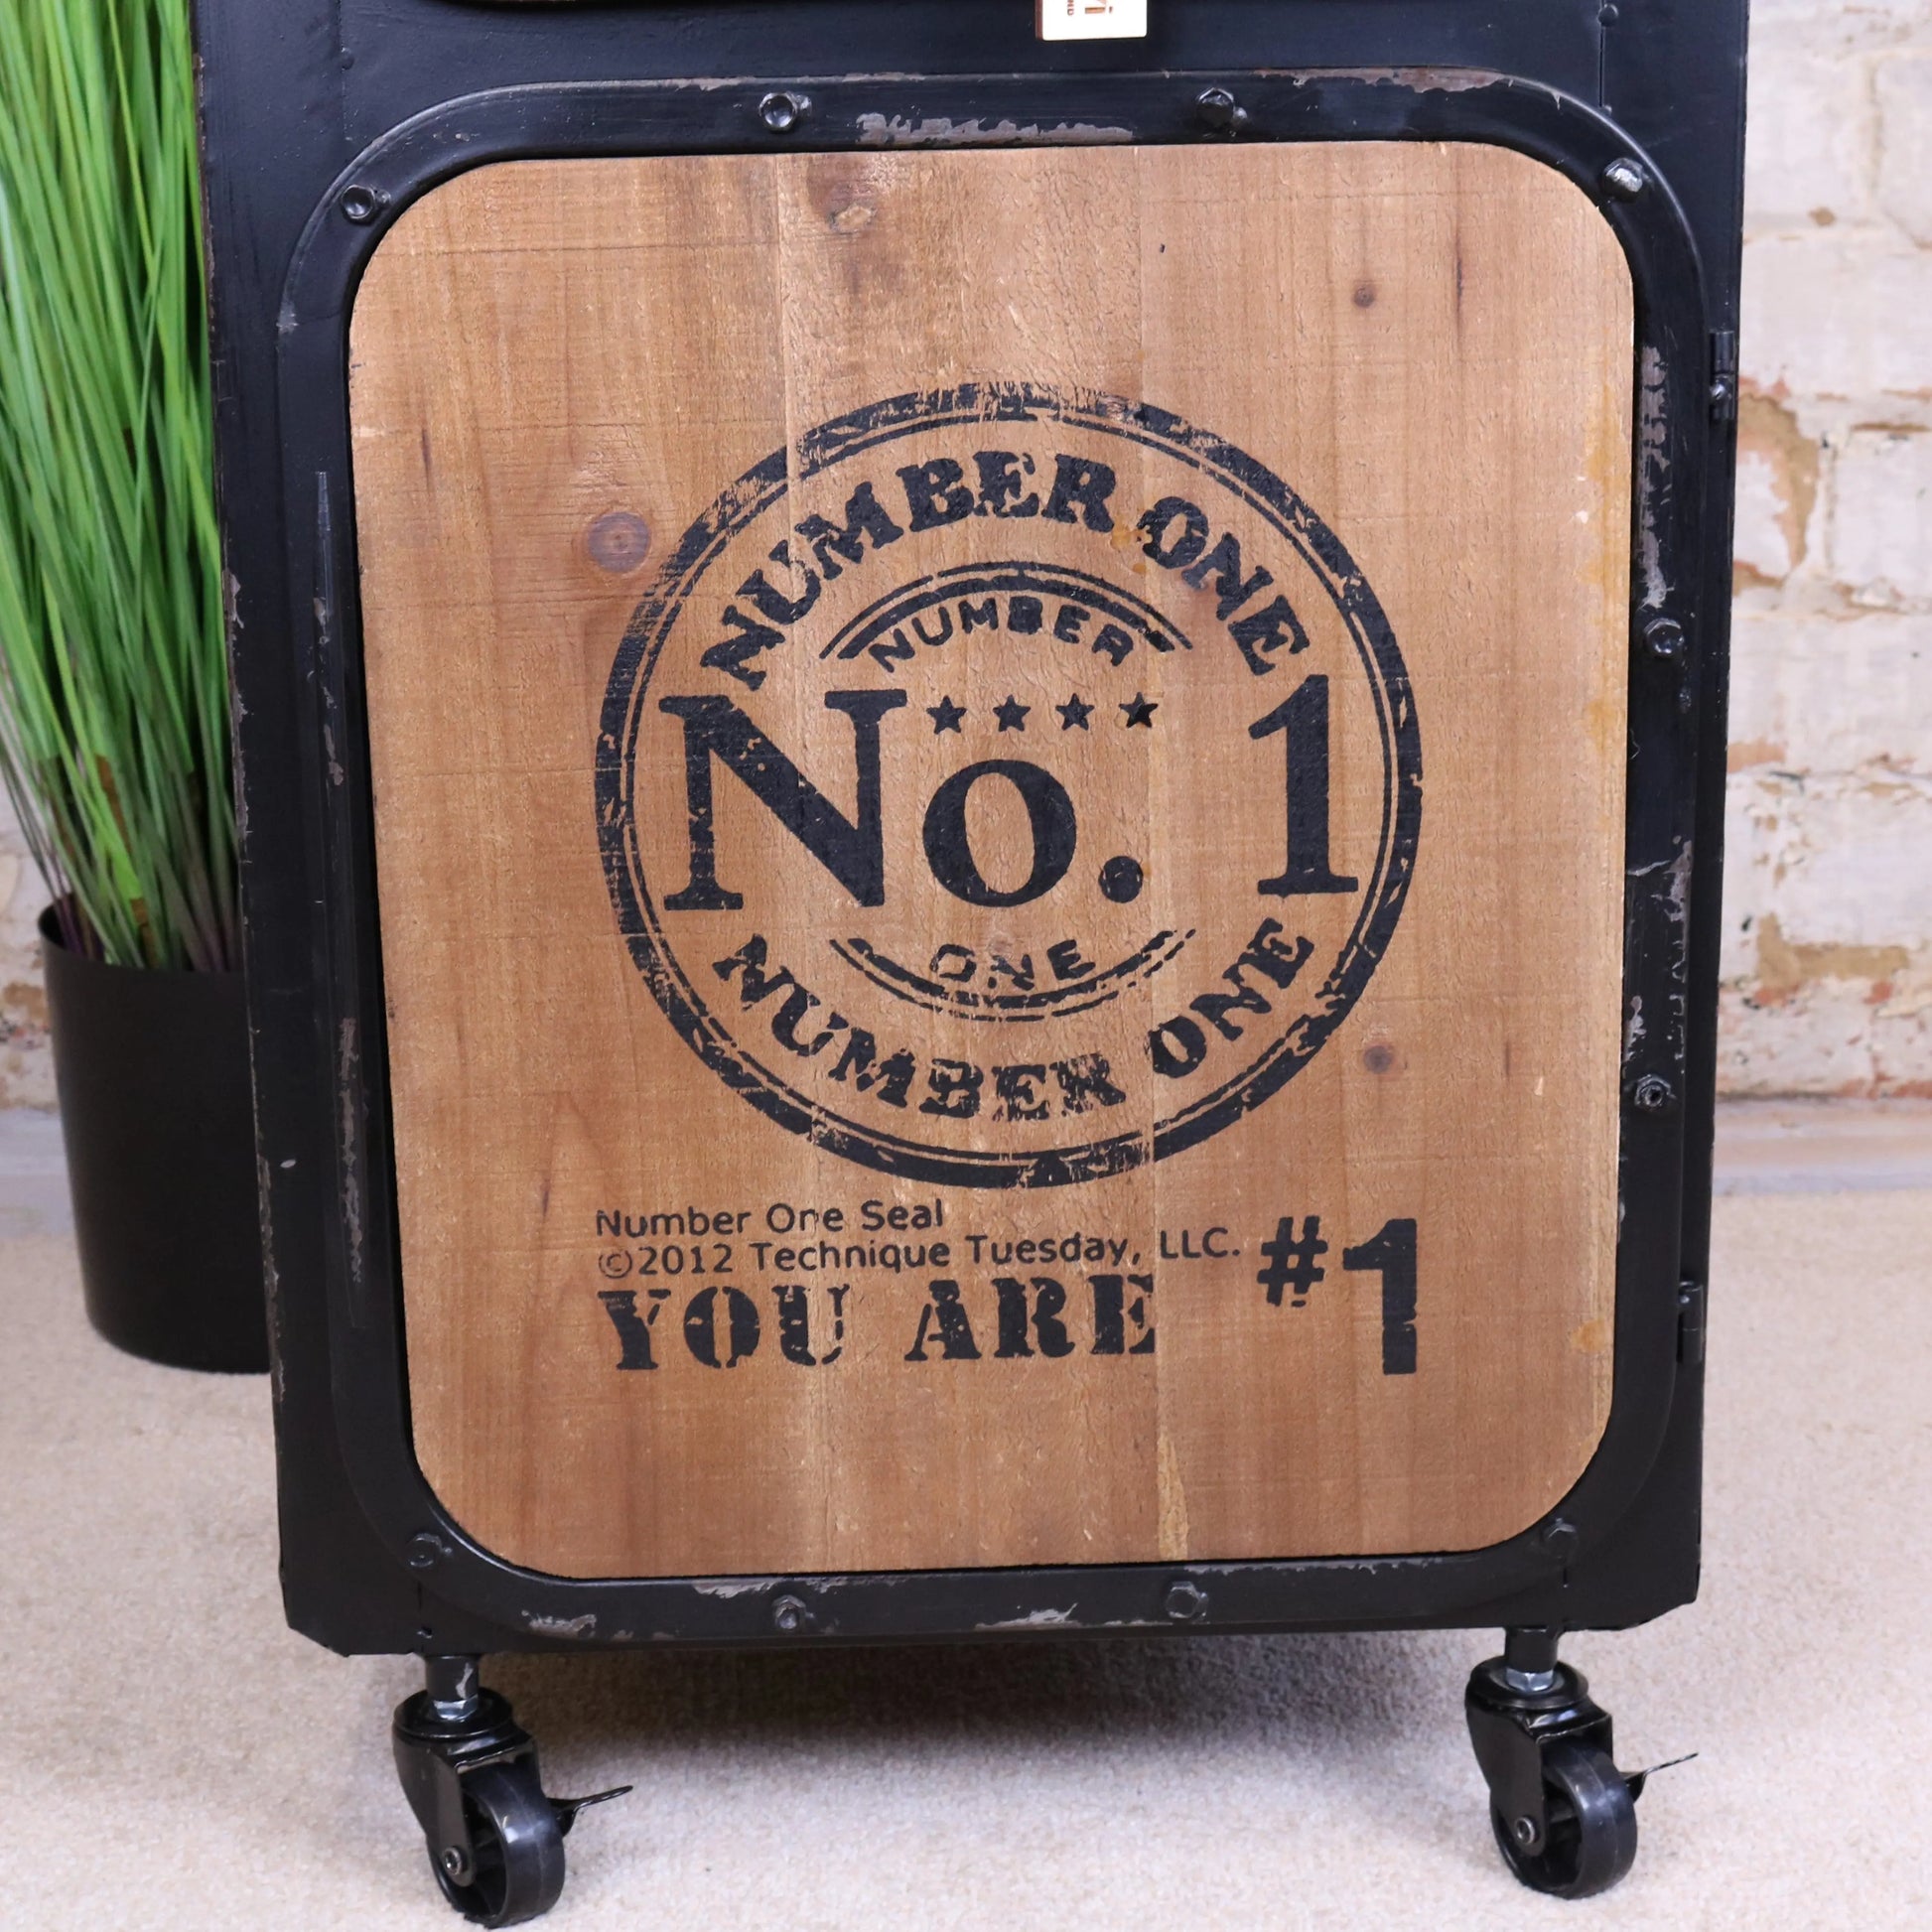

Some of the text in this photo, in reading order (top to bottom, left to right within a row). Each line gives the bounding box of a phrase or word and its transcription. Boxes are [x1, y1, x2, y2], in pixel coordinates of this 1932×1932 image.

[701, 451, 1309, 690] NUMBER ONE
[869, 596, 1135, 672] NUMBER
[658, 674, 1358, 910] No. 1
[930, 939, 1096, 991] ONE
[712, 917, 1315, 1121] NUMBER ONE
[596, 1198, 943, 1238] Number One Seal
[749, 1241, 951, 1274] Technique
[965, 1232, 1142, 1266] Tuesday,
[1160, 1227, 1241, 1259] LLC.
[598, 1284, 851, 1370] YOU
[904, 1274, 1157, 1361] ARE
